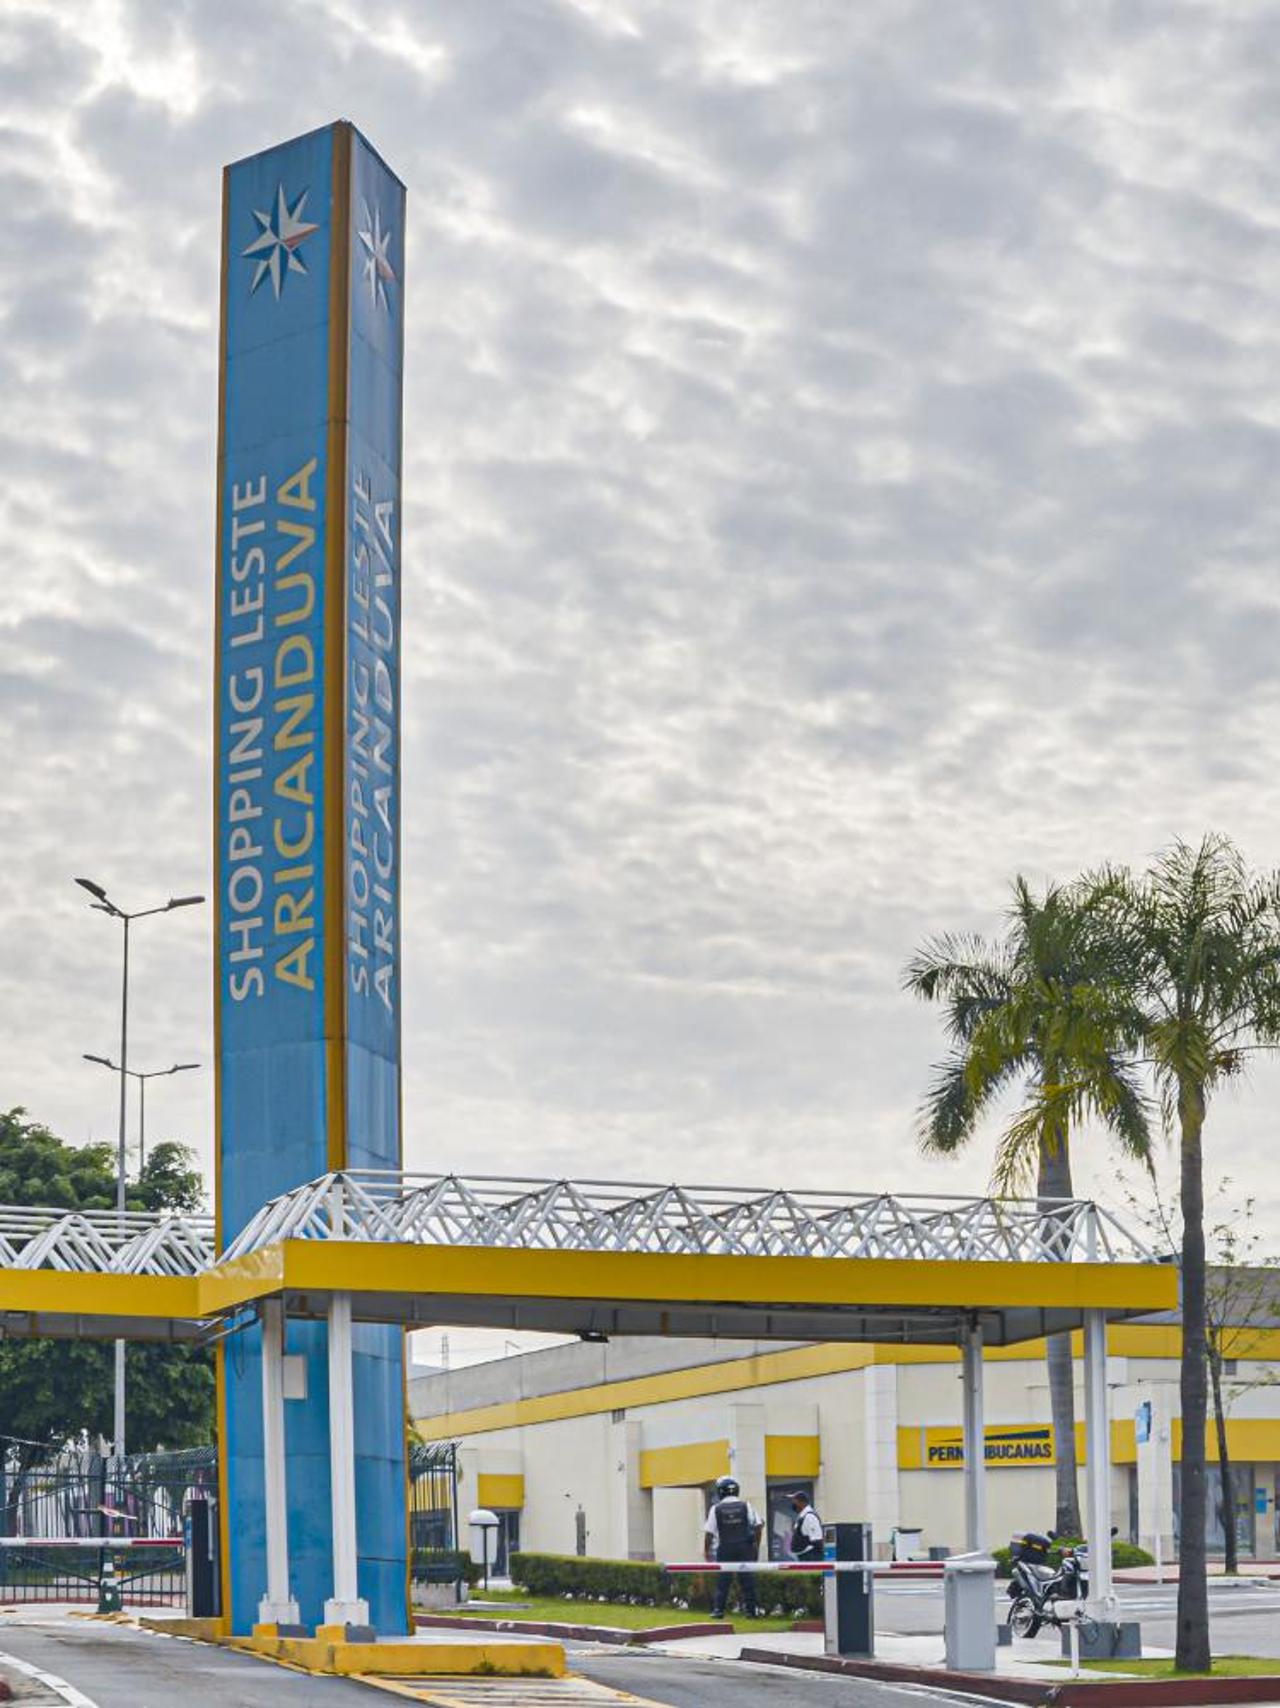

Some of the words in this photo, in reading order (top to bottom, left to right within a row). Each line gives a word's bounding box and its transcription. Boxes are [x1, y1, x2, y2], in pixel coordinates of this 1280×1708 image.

[230, 474, 268, 648] LESTE
[273, 456, 319, 992] ARICANDUVA
[229, 666, 265, 1001] SHOPPING
[350, 656, 370, 998] SHOPPING
[373, 500, 394, 1012] ARICANDUVA
[929, 1444, 1052, 1461] PERNBUCANAS
